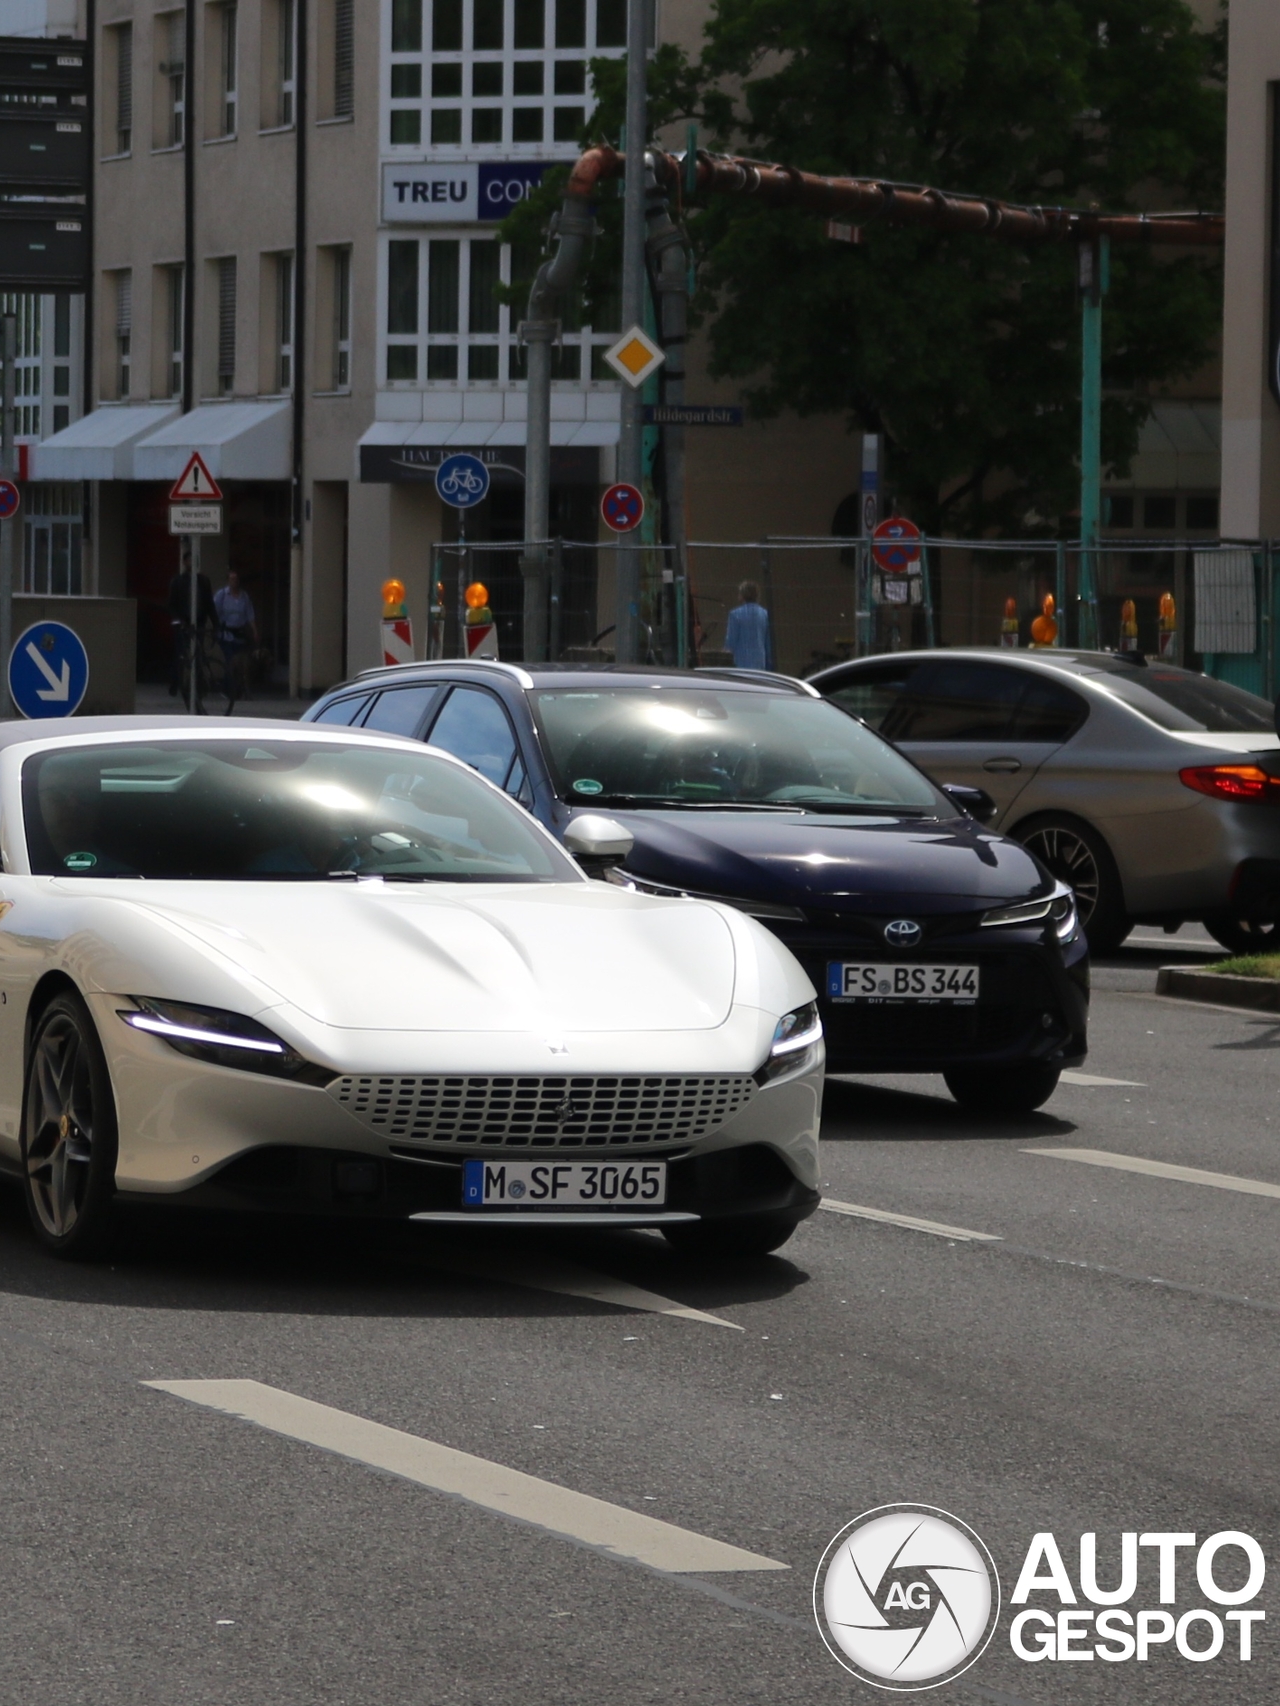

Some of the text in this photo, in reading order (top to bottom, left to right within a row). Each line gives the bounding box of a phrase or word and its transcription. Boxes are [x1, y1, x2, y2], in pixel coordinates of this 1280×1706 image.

[394, 179, 544, 203] TREU CON
[653, 406, 733, 425] Hildegardstr.
[174, 520, 218, 530] Notausgang
[844, 967, 876, 993] FS
[894, 968, 926, 993] BS
[931, 969, 976, 994] 344
[470, 1166, 660, 1199] D M SF 3065
